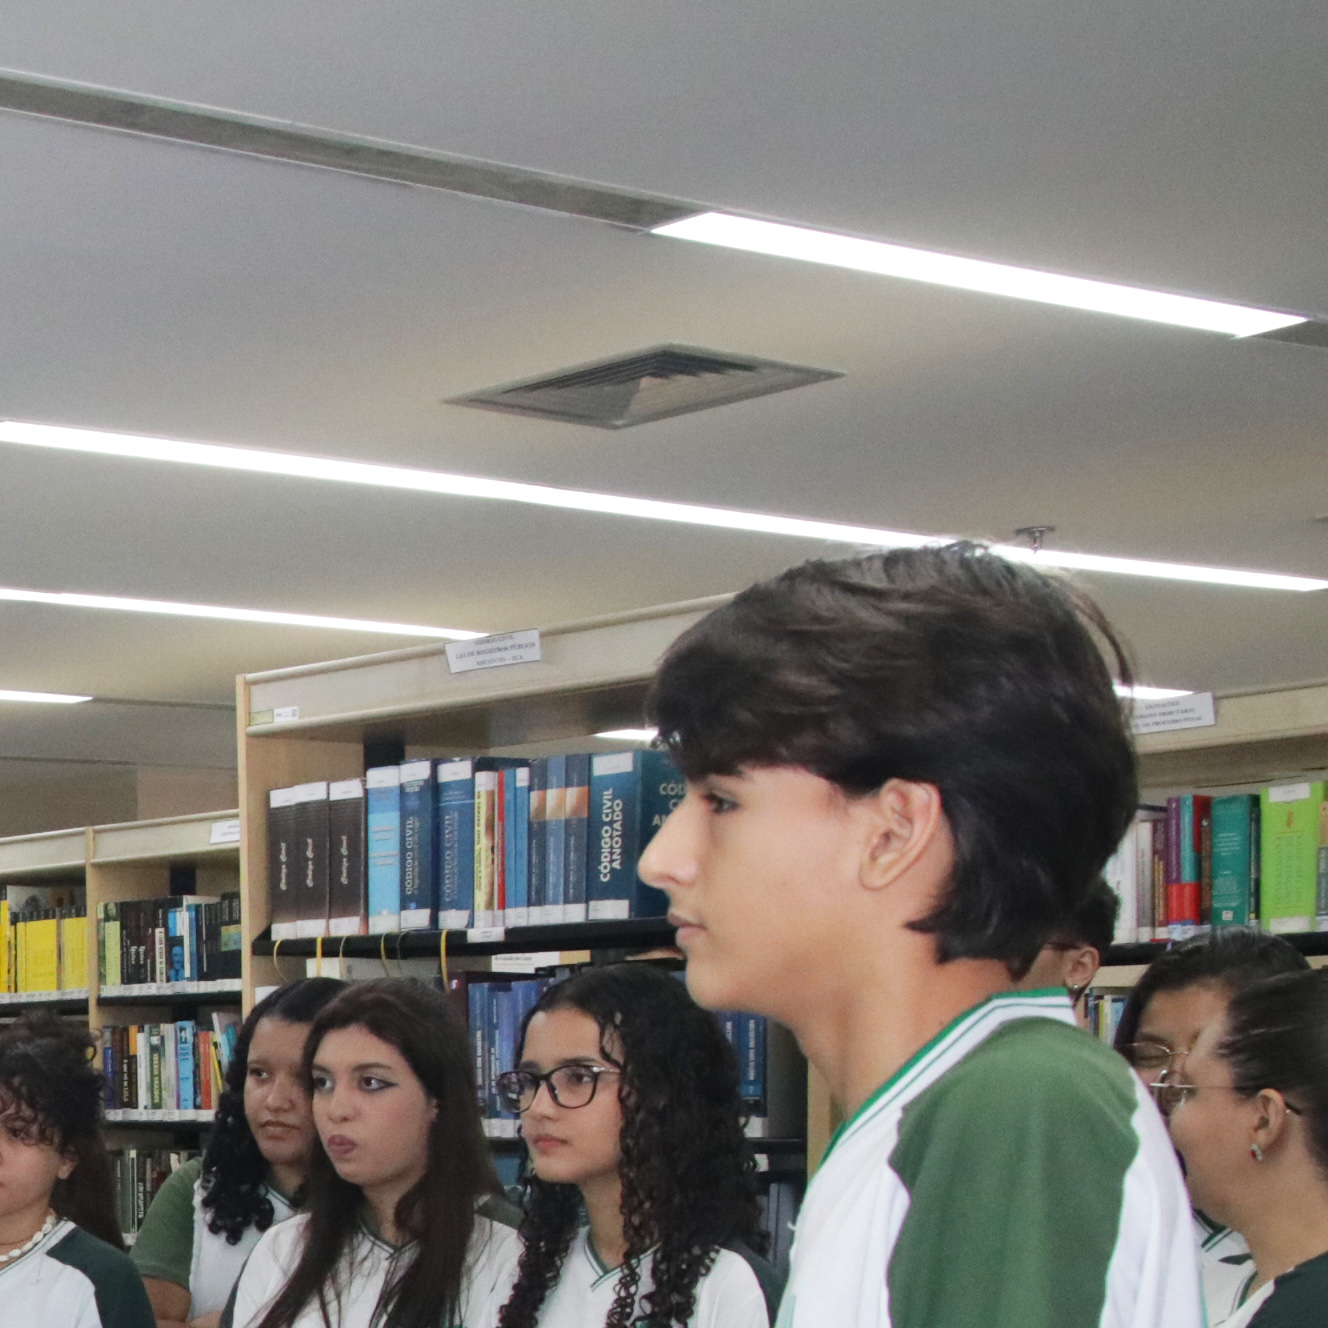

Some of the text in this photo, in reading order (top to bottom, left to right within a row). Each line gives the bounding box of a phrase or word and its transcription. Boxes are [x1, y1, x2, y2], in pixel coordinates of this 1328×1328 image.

[659, 781, 687, 796] CÓD
[443, 810, 453, 902] CÓDIGO CIVIL
[598, 787, 613, 882] CÓDIGO CIVIL
[611, 799, 623, 870] ANOTADO
[405, 852, 413, 894] CÓDIGO
